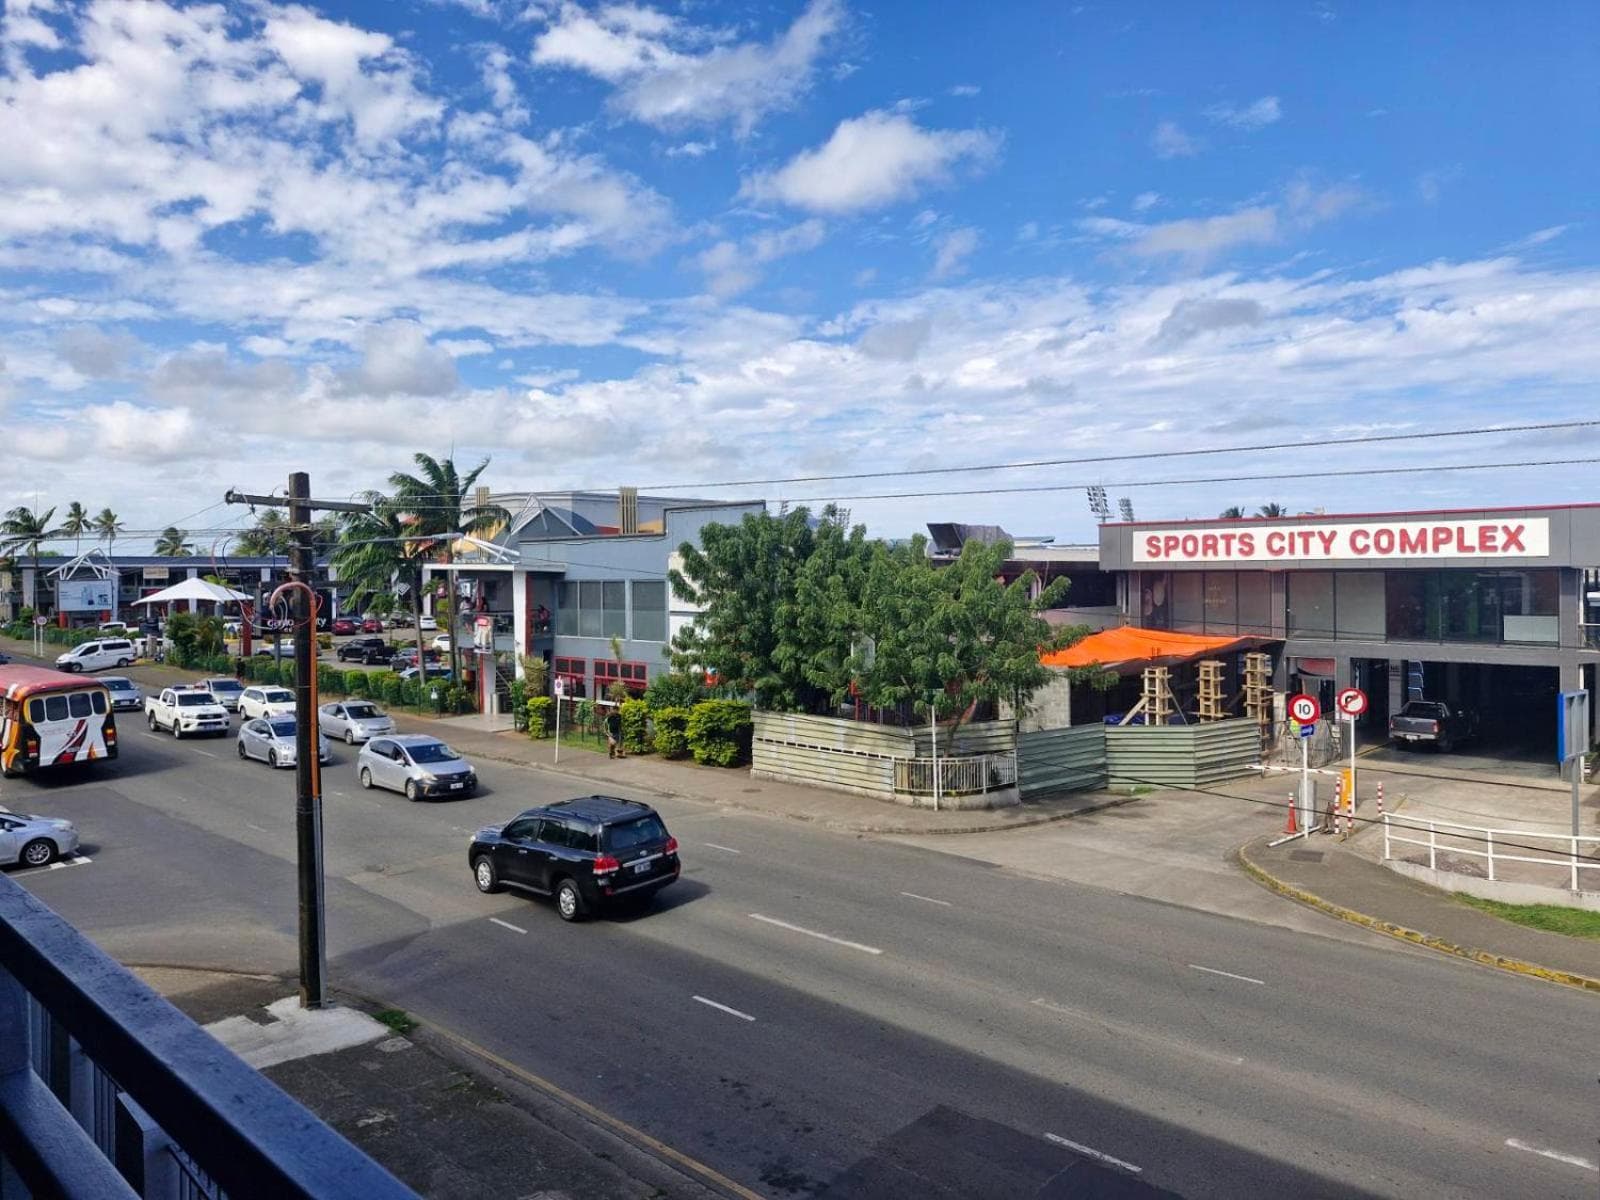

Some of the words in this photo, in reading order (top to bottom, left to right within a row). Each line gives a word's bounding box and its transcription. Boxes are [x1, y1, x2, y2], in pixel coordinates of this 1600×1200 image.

[1147, 532, 1254, 558] SPORTS
[1267, 529, 1337, 556] CITY
[1350, 525, 1525, 555] COMPLEX
[1299, 703, 1311, 716] 10
